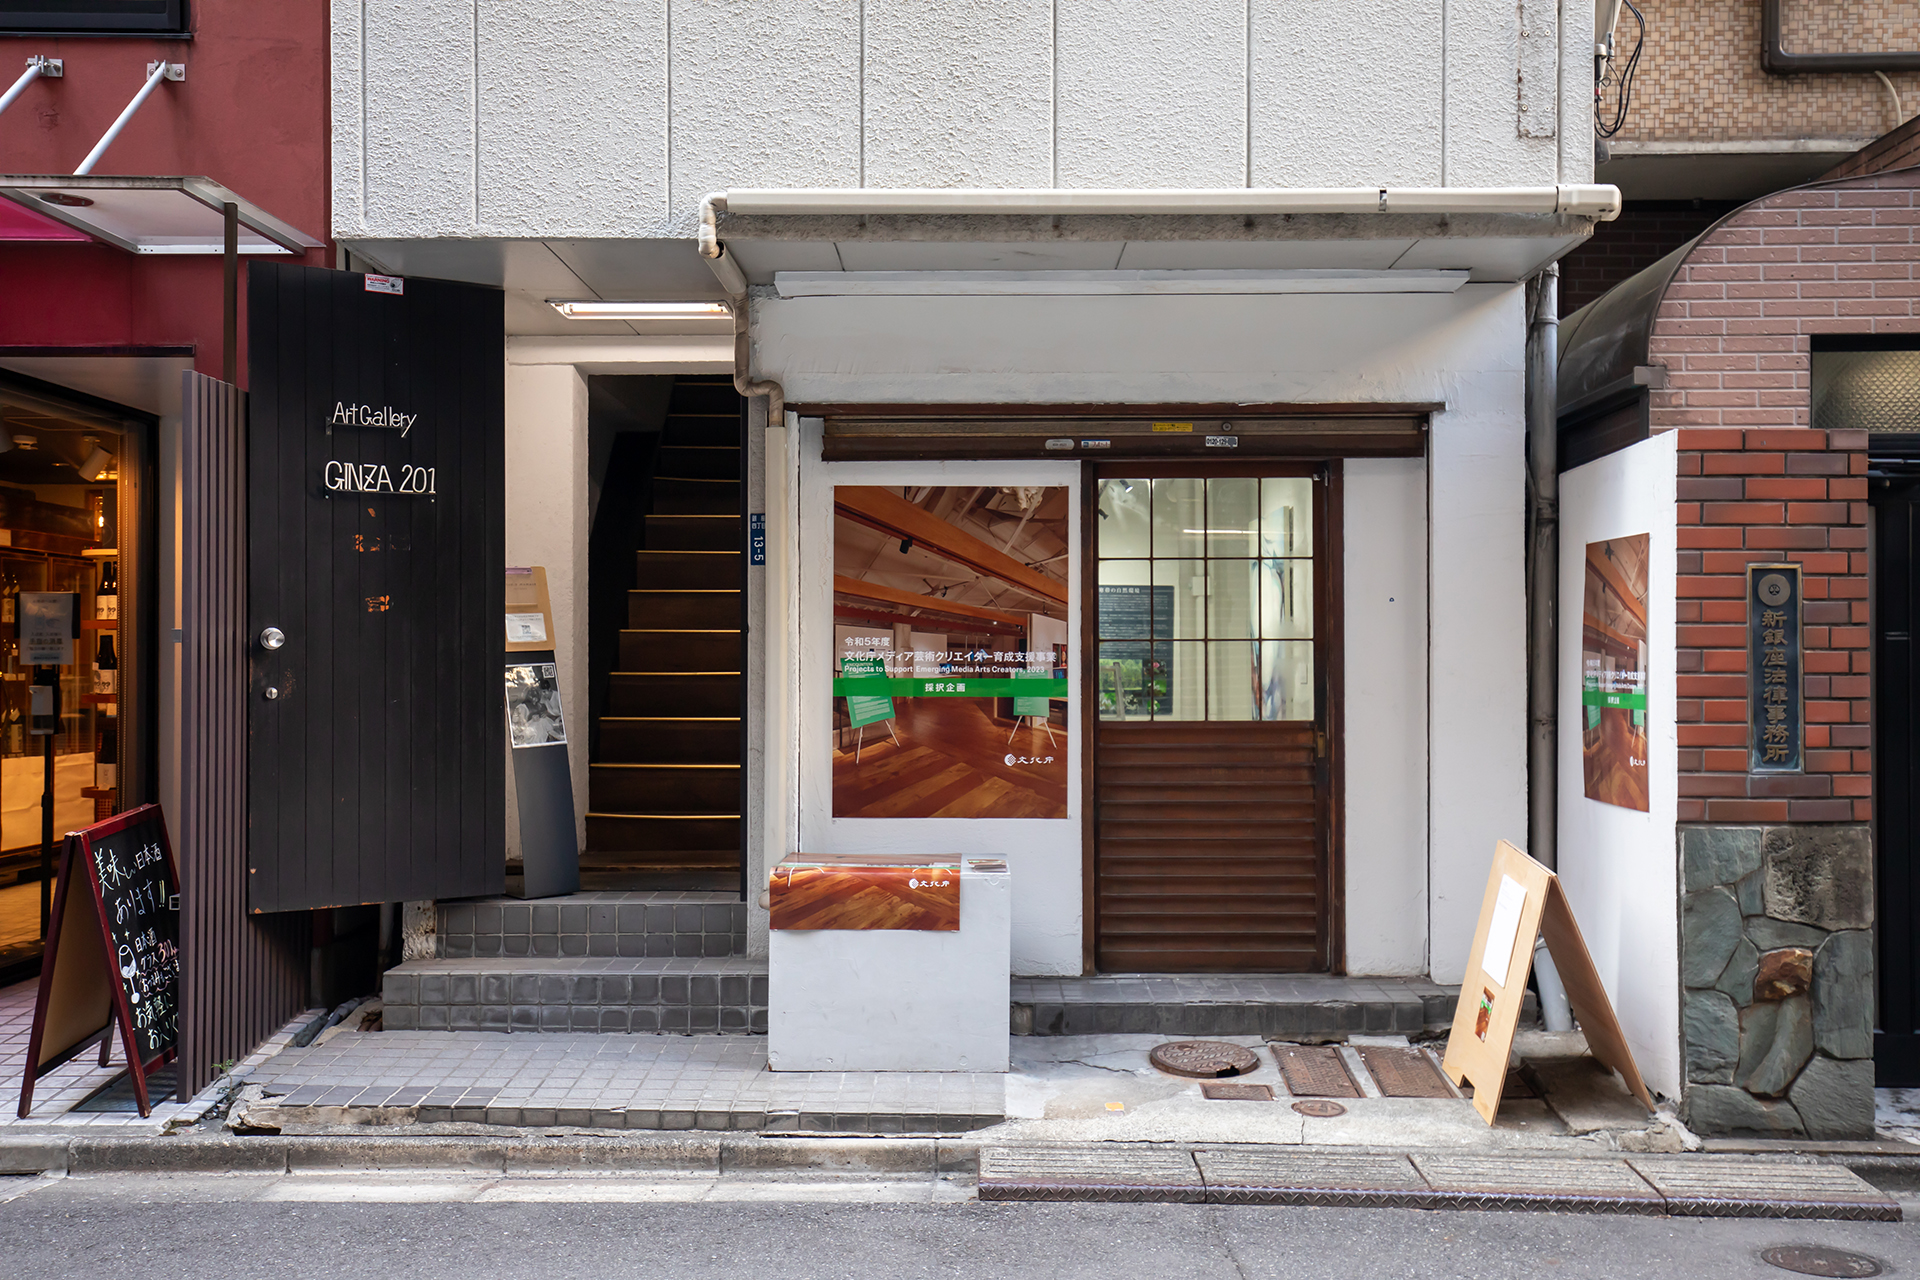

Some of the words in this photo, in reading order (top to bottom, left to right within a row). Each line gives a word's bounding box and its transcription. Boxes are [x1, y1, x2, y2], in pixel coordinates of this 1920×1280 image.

[332, 401, 359, 425] Art
[360, 404, 418, 438] Gallery
[325, 460, 394, 492] GINZA
[399, 464, 436, 494] 201
[753, 536, 764, 561] 13-5
[844, 636, 891, 647] 令和5年度
[844, 650, 1057, 662] 文化庁メディア芸術クリエイター育成支援事業
[844, 665, 875, 673] Projects
[884, 666, 914, 674] Support
[916, 666, 950, 675] Emerging
[991, 666, 1026, 674] Creators,
[924, 682, 966, 693] 採択企画
[1762, 609, 1789, 762] 新銀座法律事務所
